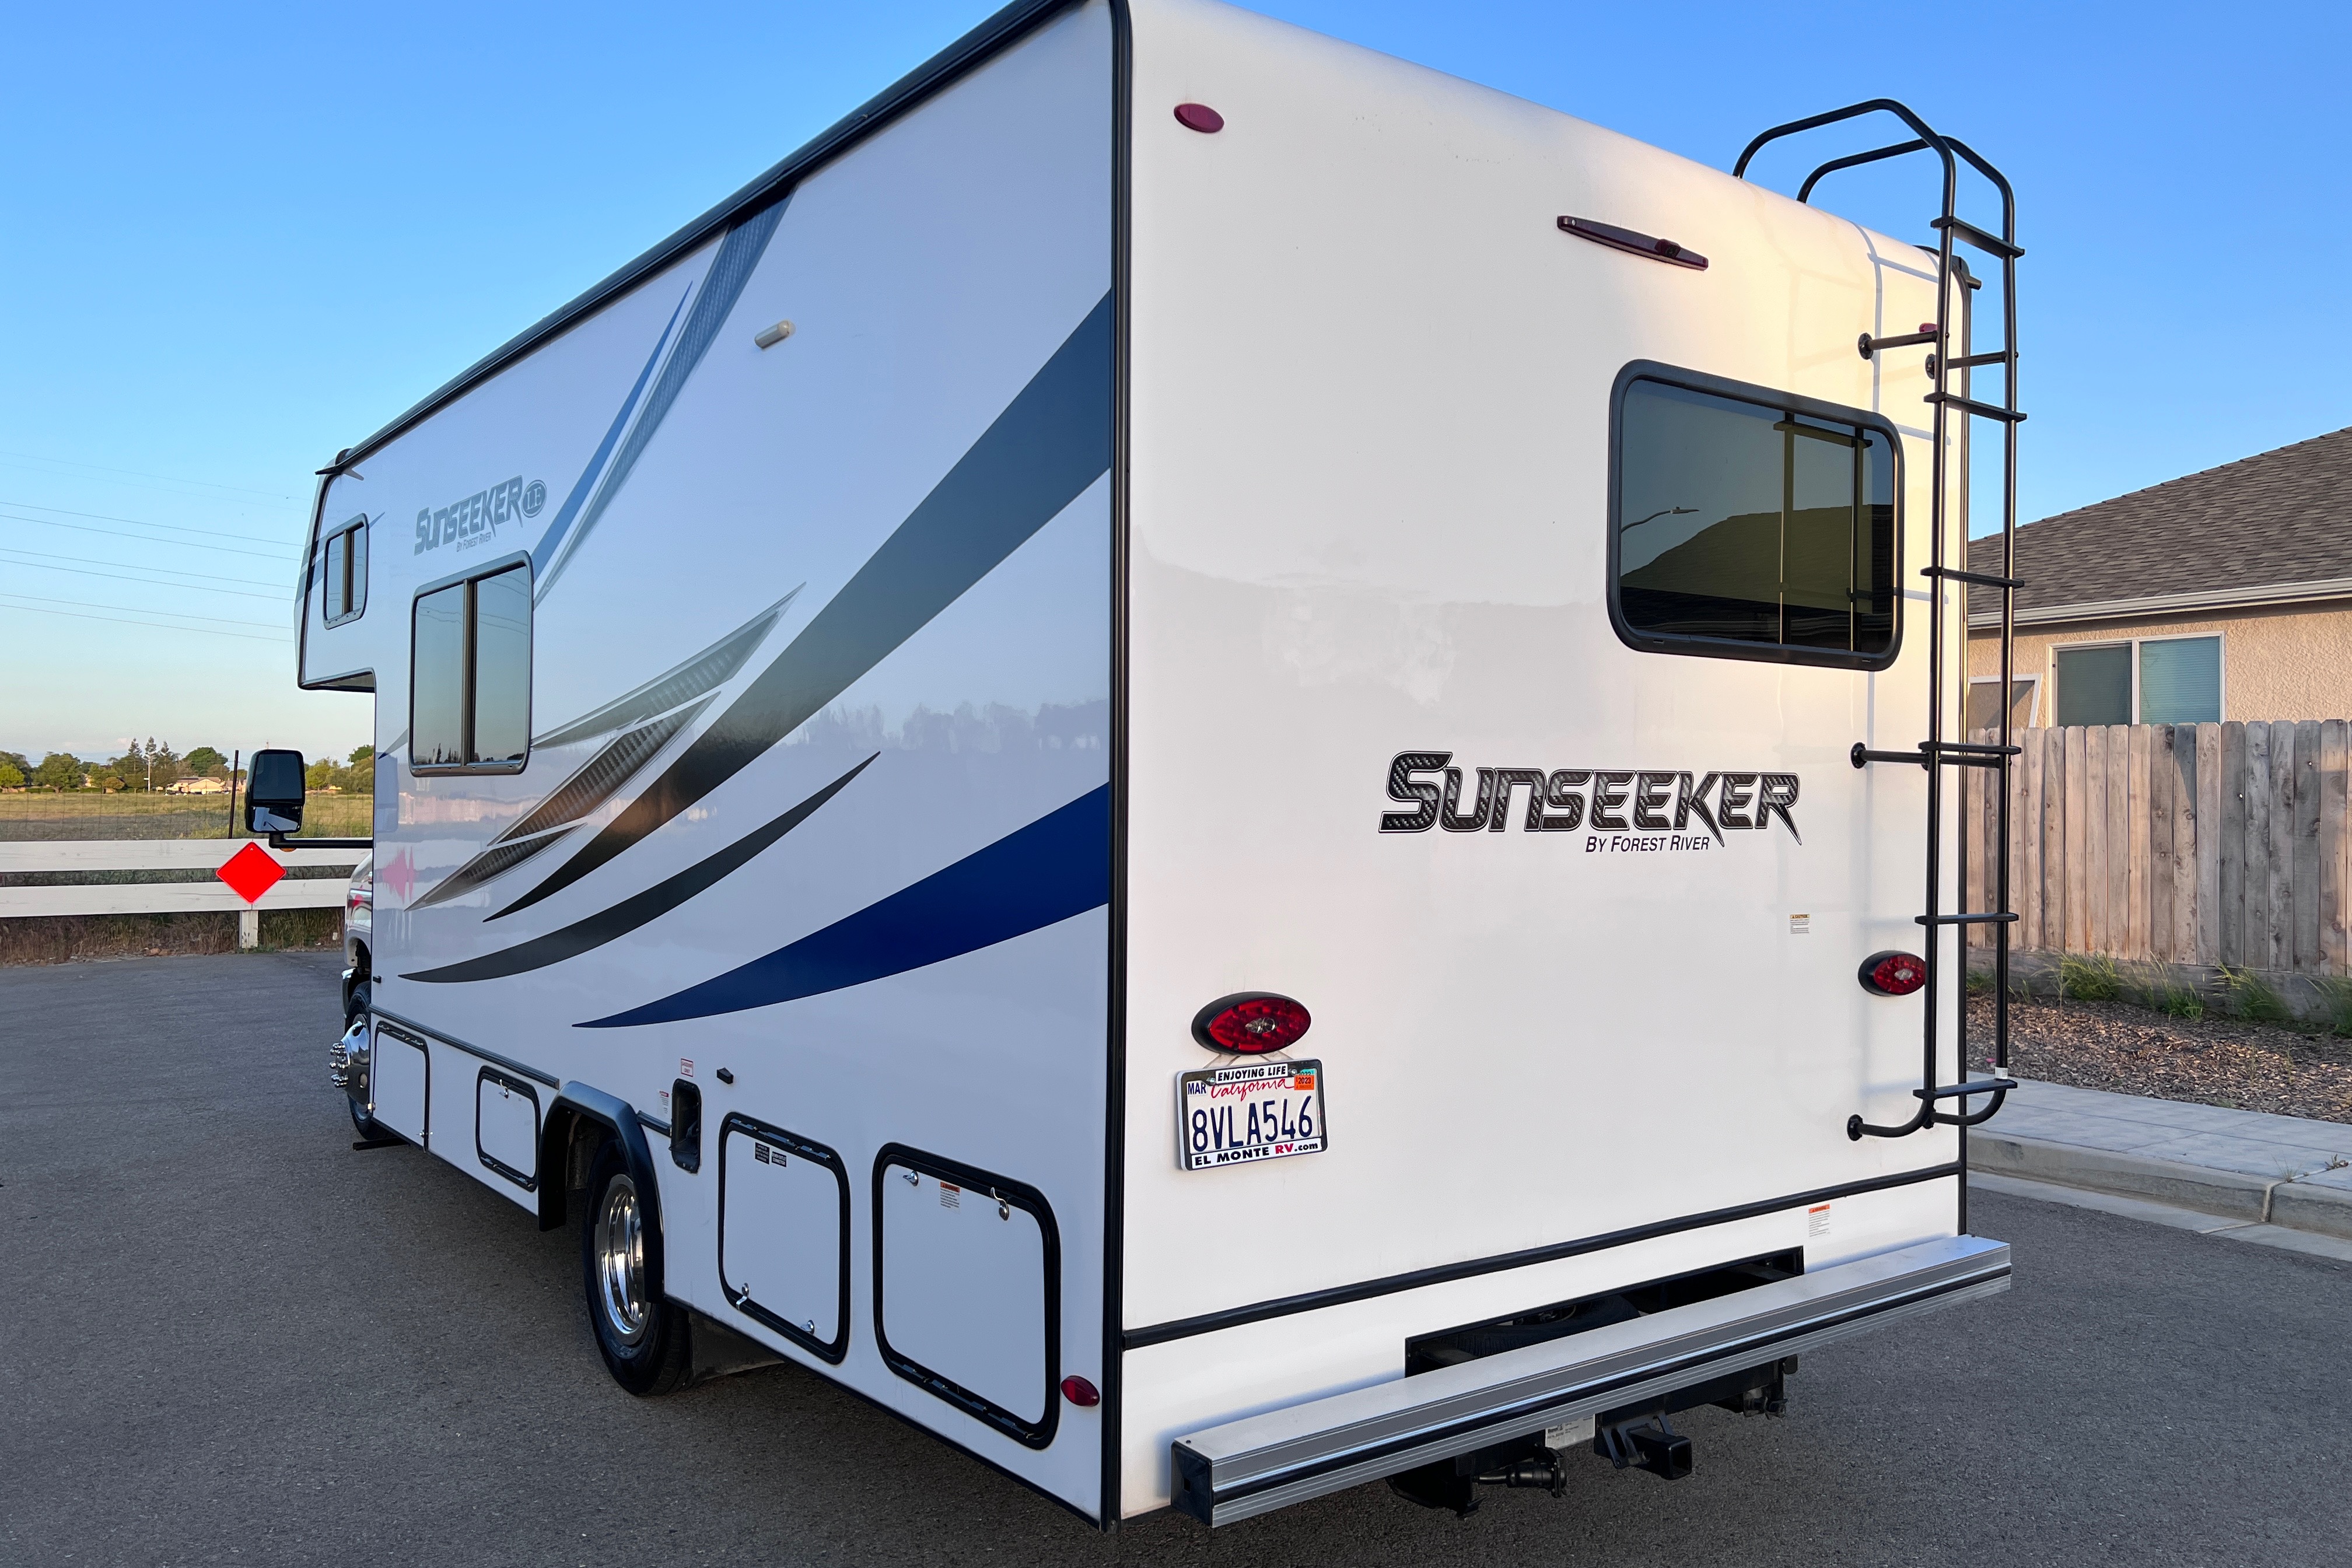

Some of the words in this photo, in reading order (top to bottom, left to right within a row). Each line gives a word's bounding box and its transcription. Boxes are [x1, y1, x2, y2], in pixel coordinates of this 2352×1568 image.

[414, 474, 523, 556] SUNSEEKER
[526, 487, 542, 511] LE
[463, 537, 478, 550] FOREST
[479, 531, 492, 544] RIVER
[1378, 750, 1802, 848] SUNSEEKER
[1585, 836, 1608, 853] BY
[1610, 835, 1667, 852] FOREST
[1670, 835, 1710, 851] RIVER
[1217, 1068, 1265, 1082] ENJOYING
[1268, 1065, 1287, 1076] LIFE
[1187, 1082, 1207, 1096] MAR
[1210, 1078, 1295, 1102] California
[1192, 1095, 1312, 1152] 8VLA546
[1195, 1154, 1212, 1166] EL
[1216, 1146, 1269, 1163] MONTE
